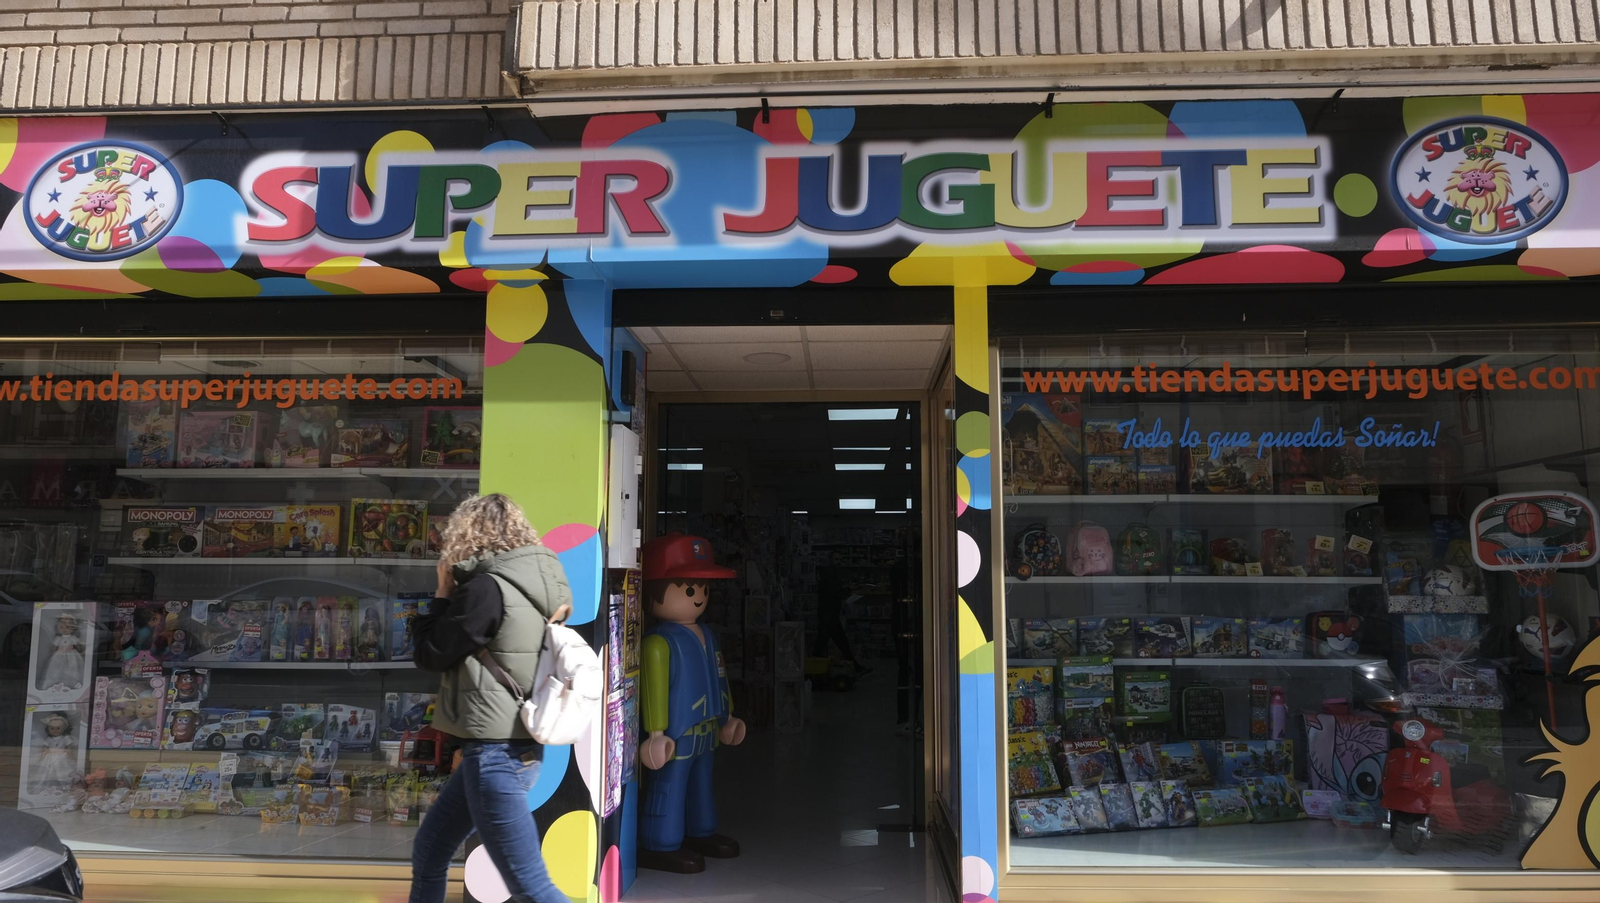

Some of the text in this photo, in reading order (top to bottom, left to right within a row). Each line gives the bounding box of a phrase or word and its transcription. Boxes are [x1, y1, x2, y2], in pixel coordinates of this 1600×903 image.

[1421, 126, 1533, 162] SUPER
[57, 149, 157, 184] SUPER
[247, 146, 1325, 242] SUPER JUGUETE
[1406, 185, 1554, 236] JUGUETE
[35, 205, 166, 252] JUGUETE
[1022, 360, 1600, 400] www.tiendasuperjuguete.com
[1116, 417, 1441, 460] Todo lo que puedas Soñar!
[129, 510, 195, 521] MONOPOLY
[217, 510, 273, 520] MONOPOLY
